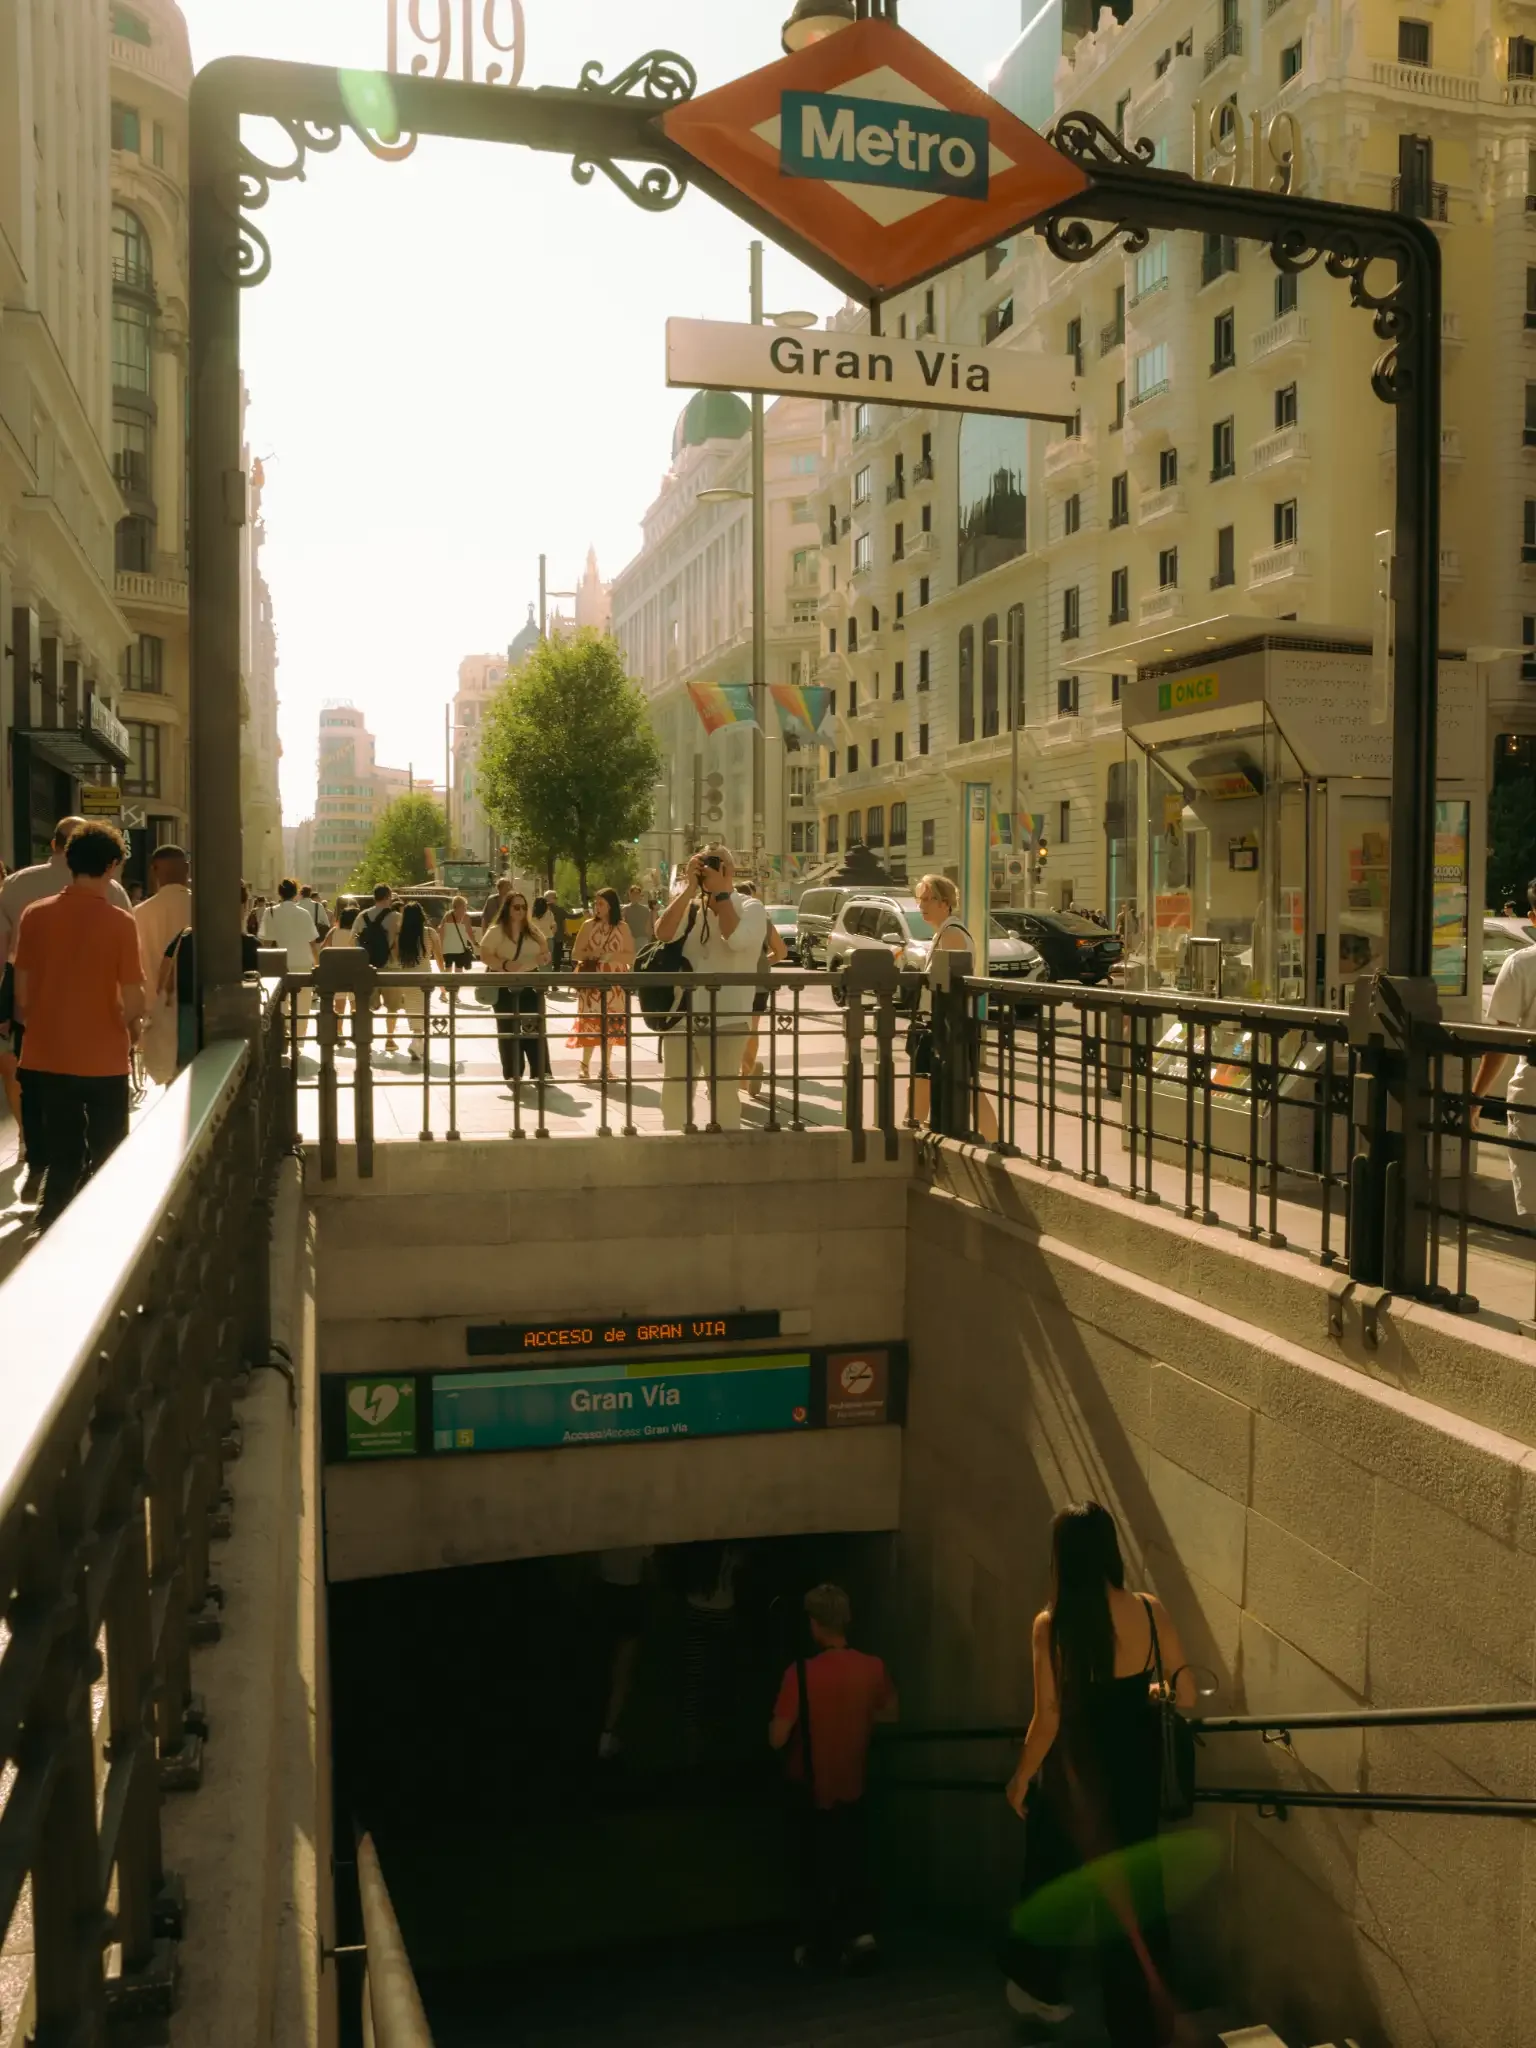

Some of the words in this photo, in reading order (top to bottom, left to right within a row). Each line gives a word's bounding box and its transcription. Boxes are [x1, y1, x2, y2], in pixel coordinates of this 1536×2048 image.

[386, 0, 525, 88] 1919
[801, 104, 977, 178] Metro
[1191, 98, 1303, 198] 1919
[769, 335, 894, 383] Gran
[914, 349, 991, 393] Vía
[1175, 678, 1214, 702] ONCE
[524, 1329, 594, 1347] ACCESO
[604, 1327, 627, 1343] de
[637, 1323, 683, 1341] GRAN
[692, 1321, 726, 1336] VIA
[570, 1388, 634, 1412] Gran
[641, 1382, 682, 1407] Vía
[644, 1424, 669, 1436] Gran
